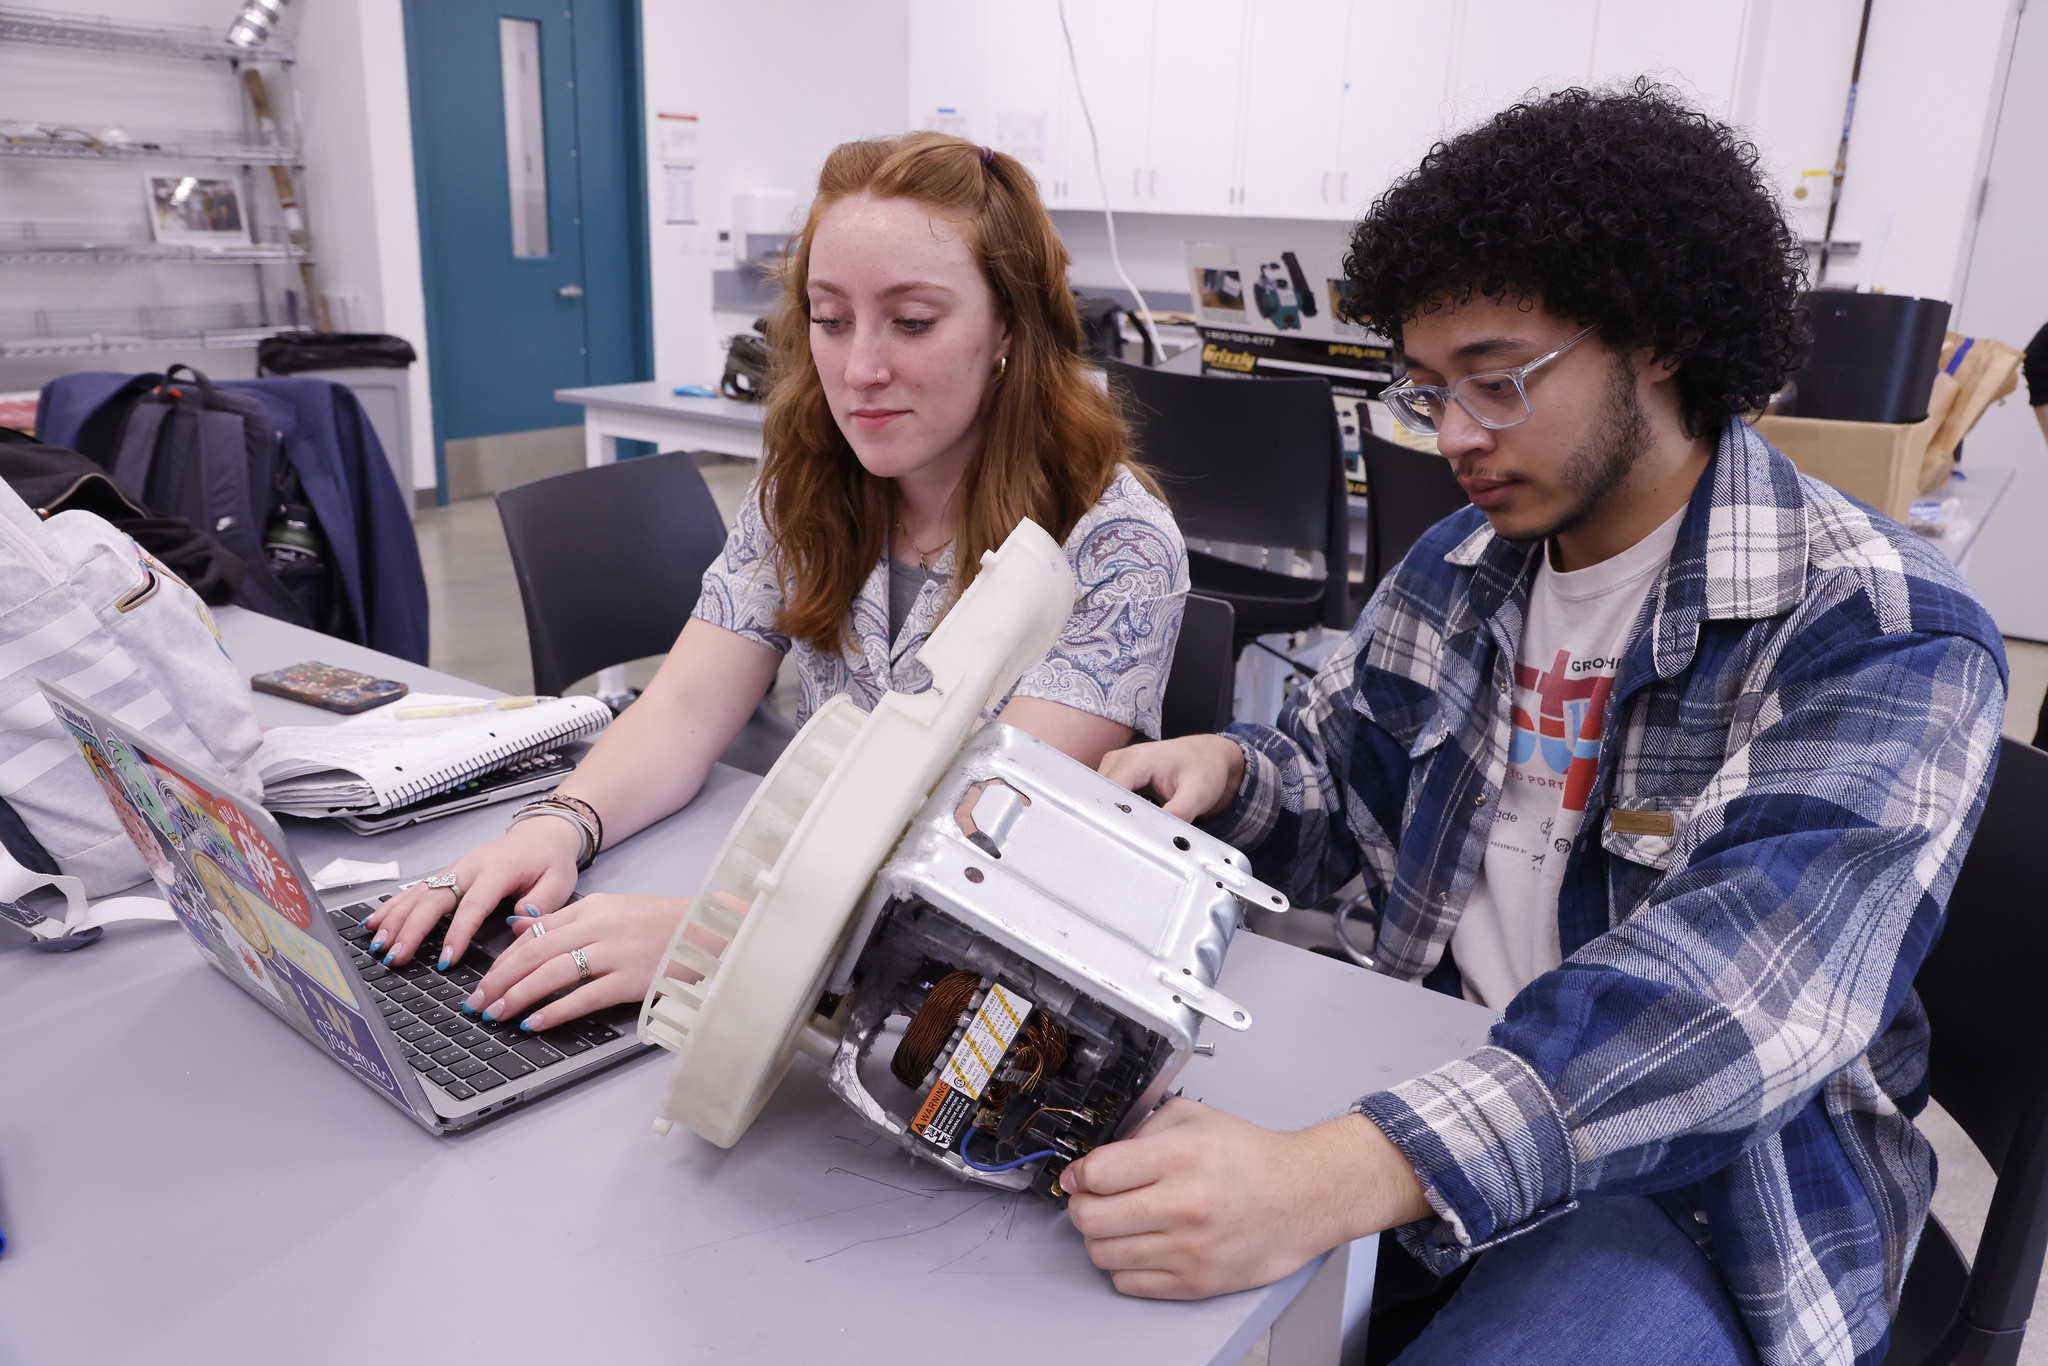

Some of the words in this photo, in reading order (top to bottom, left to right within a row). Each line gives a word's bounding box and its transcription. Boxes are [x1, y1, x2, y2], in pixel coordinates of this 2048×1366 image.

[1203, 344, 1257, 371] Grizzly
[1528, 775, 1565, 790] PORT
[1494, 810, 1518, 823] ade
[307, 984, 359, 1049] W
[316, 1019, 395, 1090] Tacoma
[920, 1082, 948, 1122] WARNING
